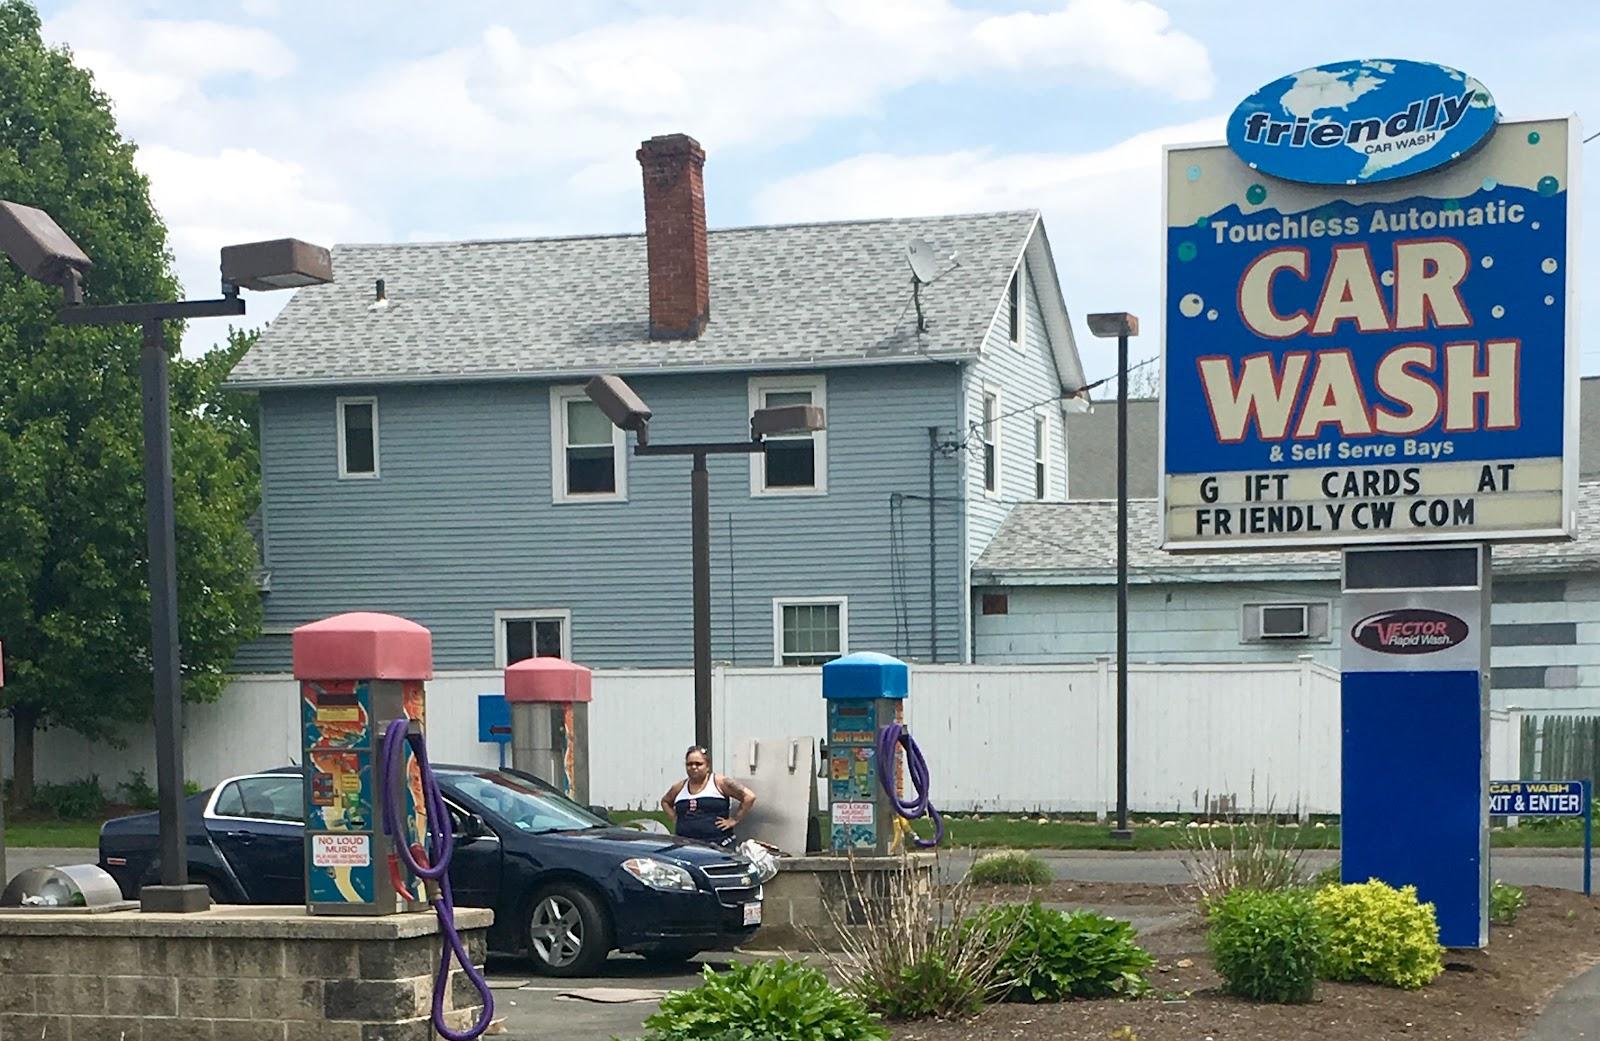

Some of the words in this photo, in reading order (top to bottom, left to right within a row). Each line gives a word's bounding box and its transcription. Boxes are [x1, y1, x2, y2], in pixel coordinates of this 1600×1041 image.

[1244, 89, 1476, 148] friendly
[1364, 143, 1392, 155] CAR
[1396, 132, 1436, 150] WASH
[1211, 215, 1360, 244] Touchless
[1369, 200, 1525, 233] Automatic
[1237, 237, 1472, 339] CAR
[1196, 338, 1521, 443] WASH
[1269, 445, 1284, 462] &
[1291, 443, 1332, 461] Self
[1337, 441, 1397, 459] Serve
[1403, 439, 1454, 459] Bays
[1321, 468, 1421, 498] CARDS
[1477, 464, 1515, 493] AT
[1409, 498, 1475, 527] COM
[1366, 621, 1447, 646] VECTOR
[1388, 634, 1420, 648] Rapid
[1420, 634, 1450, 645] Wash
[1489, 784, 1521, 793] CAR
[1526, 784, 1569, 793] WASH
[1488, 795, 1511, 811] XIT
[1514, 795, 1525, 811] &
[1529, 794, 1580, 811] ENTER
[318, 837, 333, 845] NO
[337, 837, 363, 845] LOUD
